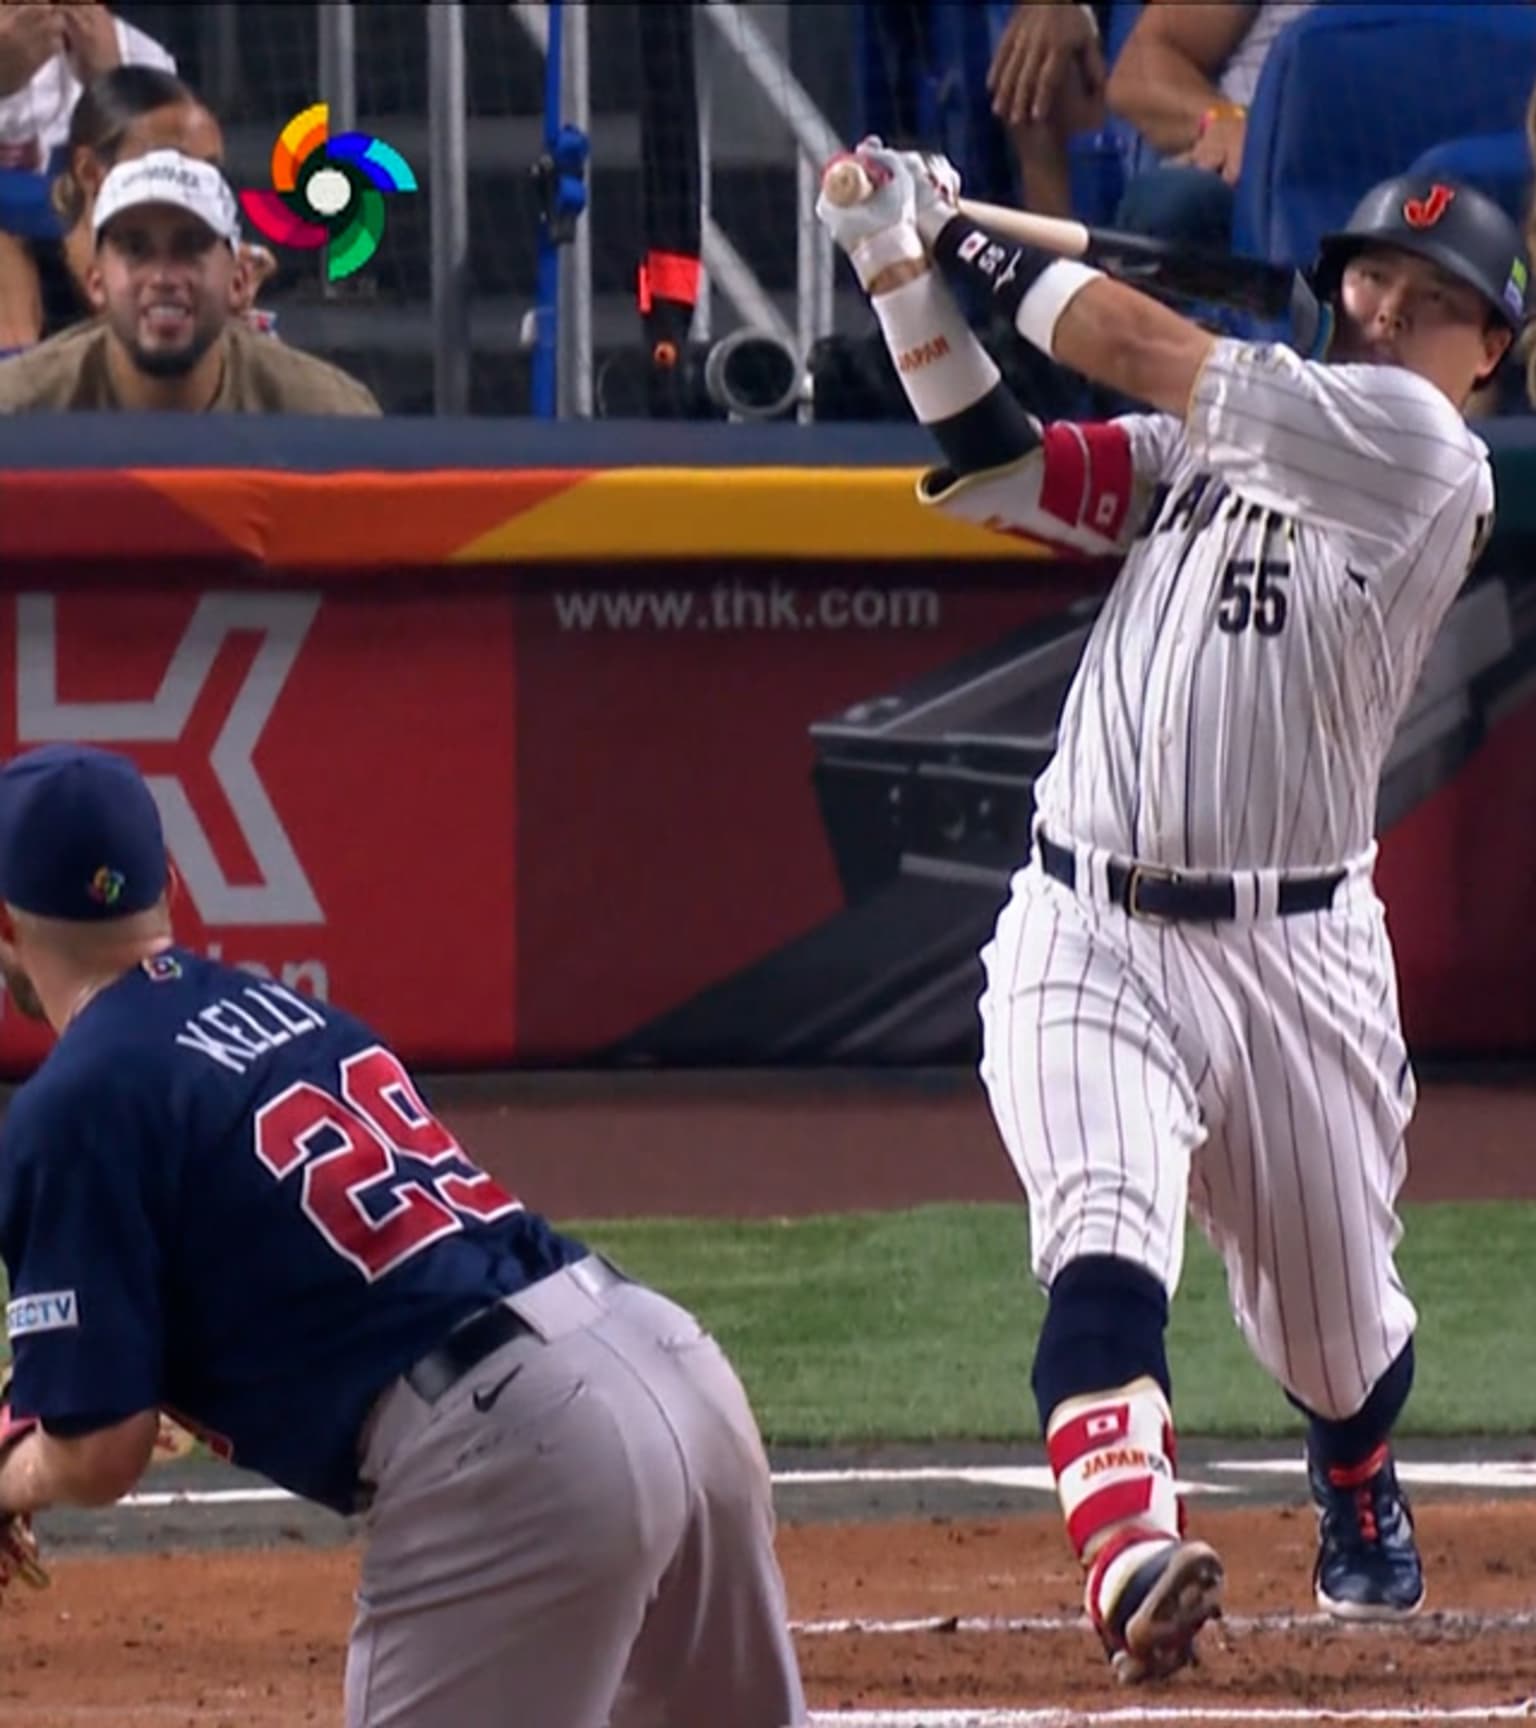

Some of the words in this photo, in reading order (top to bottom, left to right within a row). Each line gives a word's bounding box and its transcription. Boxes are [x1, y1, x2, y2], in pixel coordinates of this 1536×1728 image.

[1403, 184, 1455, 228] J
[898, 334, 950, 373] JAPAN
[554, 584, 940, 630] www.thk.com
[1218, 560, 1291, 637] 55
[254, 1045, 525, 1284] 29
[1081, 1448, 1146, 1480] JAPAN
